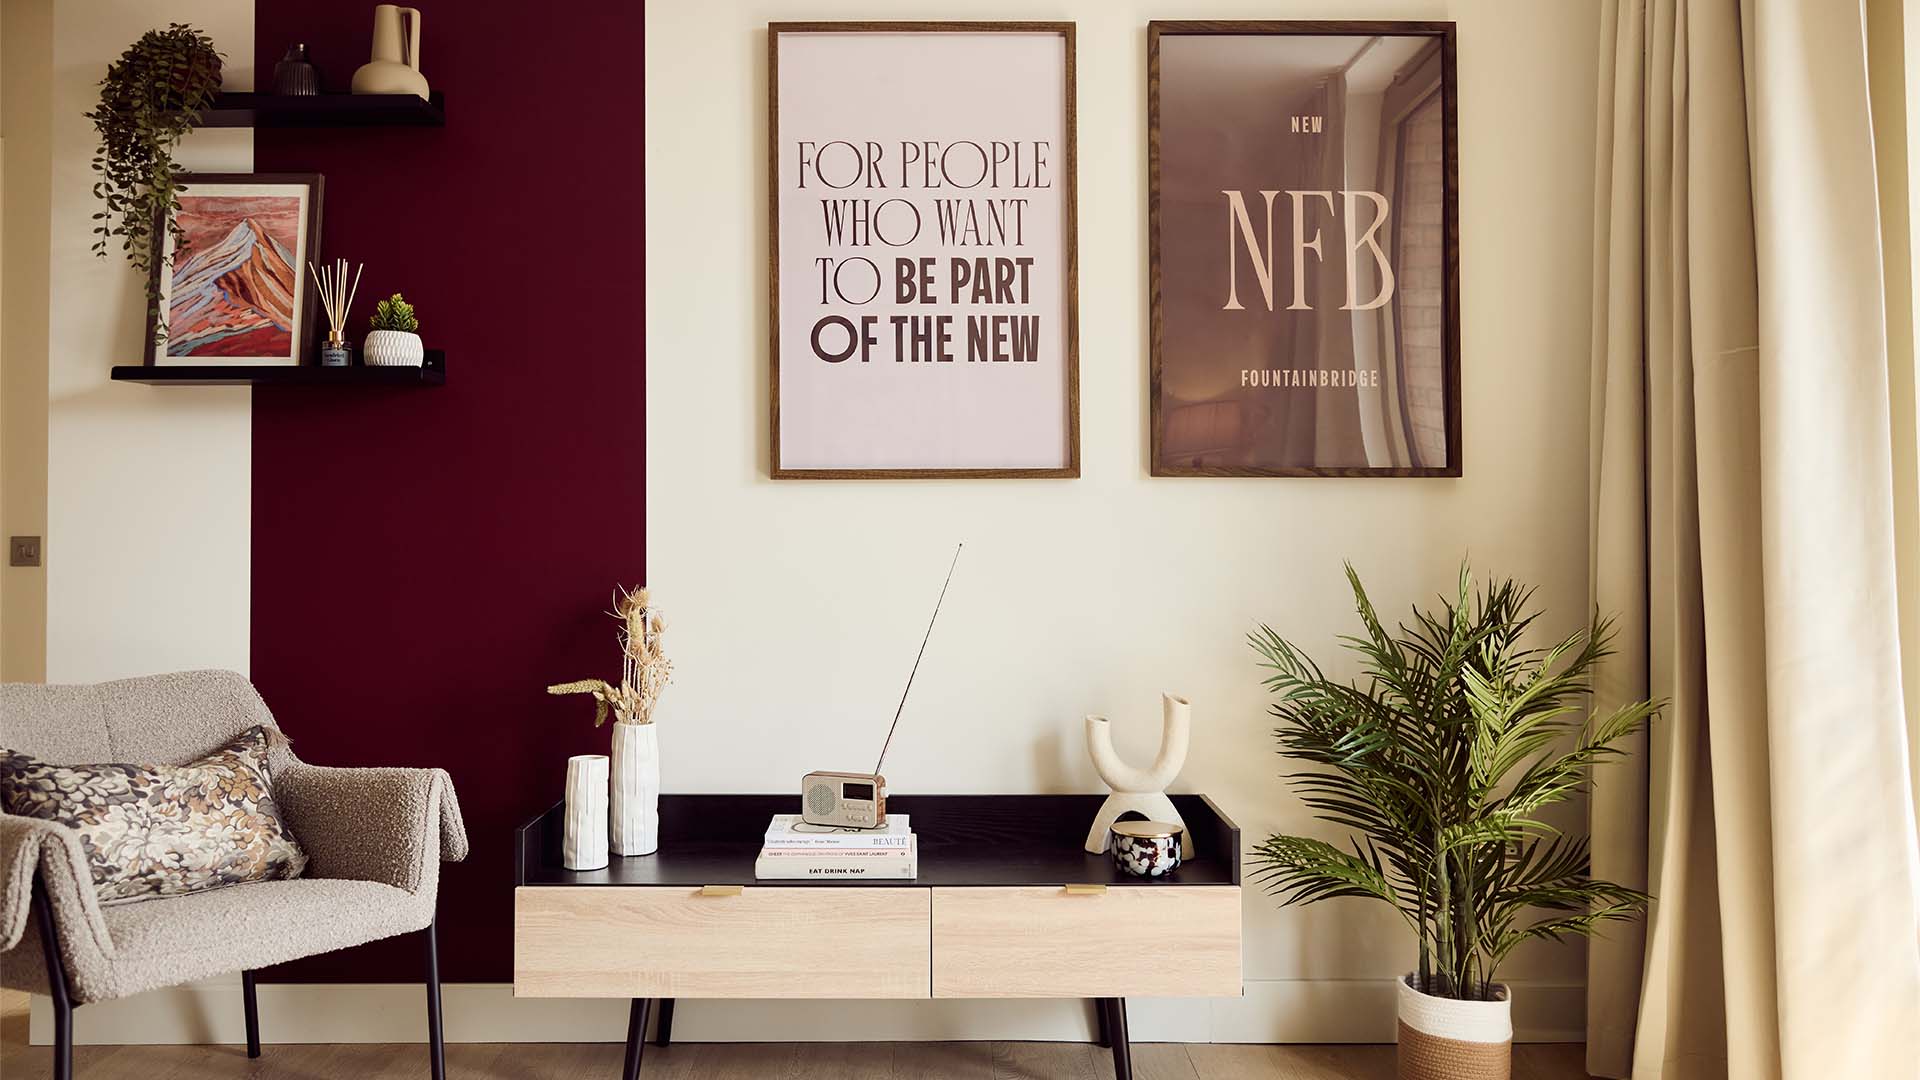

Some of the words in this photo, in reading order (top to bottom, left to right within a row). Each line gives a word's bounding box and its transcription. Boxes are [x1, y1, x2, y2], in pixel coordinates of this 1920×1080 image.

[1291, 116, 1323, 134] NEW
[798, 140, 887, 189] FOR
[900, 140, 1051, 189] PEOPLE
[820, 198, 921, 247] WHO
[934, 199, 1028, 247] WANT
[1222, 190, 1395, 312] NFB
[815, 257, 881, 305] TO
[895, 257, 937, 304] BE
[951, 257, 1034, 304] PART
[811, 315, 878, 363] OF
[890, 315, 954, 362] THE
[968, 315, 1040, 362] NEW
[1241, 369, 1378, 387] FOUNTAINBRIDGE
[873, 837, 906, 846] BEAUTÉ
